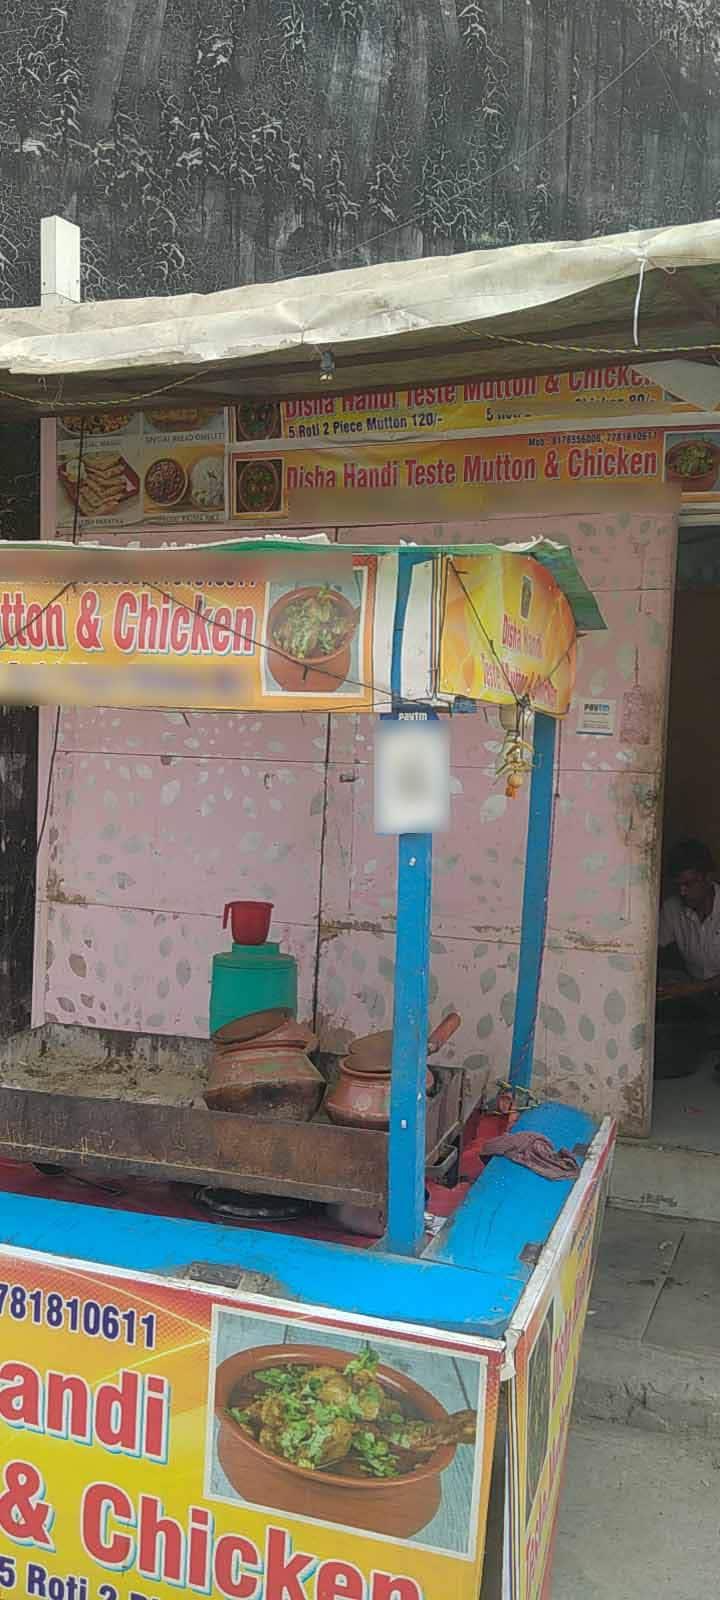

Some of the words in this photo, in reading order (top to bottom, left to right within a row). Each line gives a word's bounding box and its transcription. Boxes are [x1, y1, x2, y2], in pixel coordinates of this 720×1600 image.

[406, 383, 456, 408] Teste
[464, 376, 537, 402] Mutton
[545, 375, 561, 393] &
[289, 425, 296, 439] 5
[299, 424, 320, 438] Roti
[323, 422, 330, 435] 2
[334, 420, 363, 434] Piece
[367, 416, 408, 431] Mutton
[413, 413, 442, 428] 120/-
[286, 465, 337, 488] Disha
[343, 460, 398, 488] Handi
[405, 457, 457, 486] Teste
[464, 454, 536, 482] Mutton
[544, 449, 561, 479] &
[568, 446, 657, 478] Chicken
[76, 590, 102, 651] &
[113, 591, 255, 653] Chicken
[0, 1462, 55, 1552] &
[0, 1556, 16, 1588] 5
[27, 1563, 88, 1600] Roti
